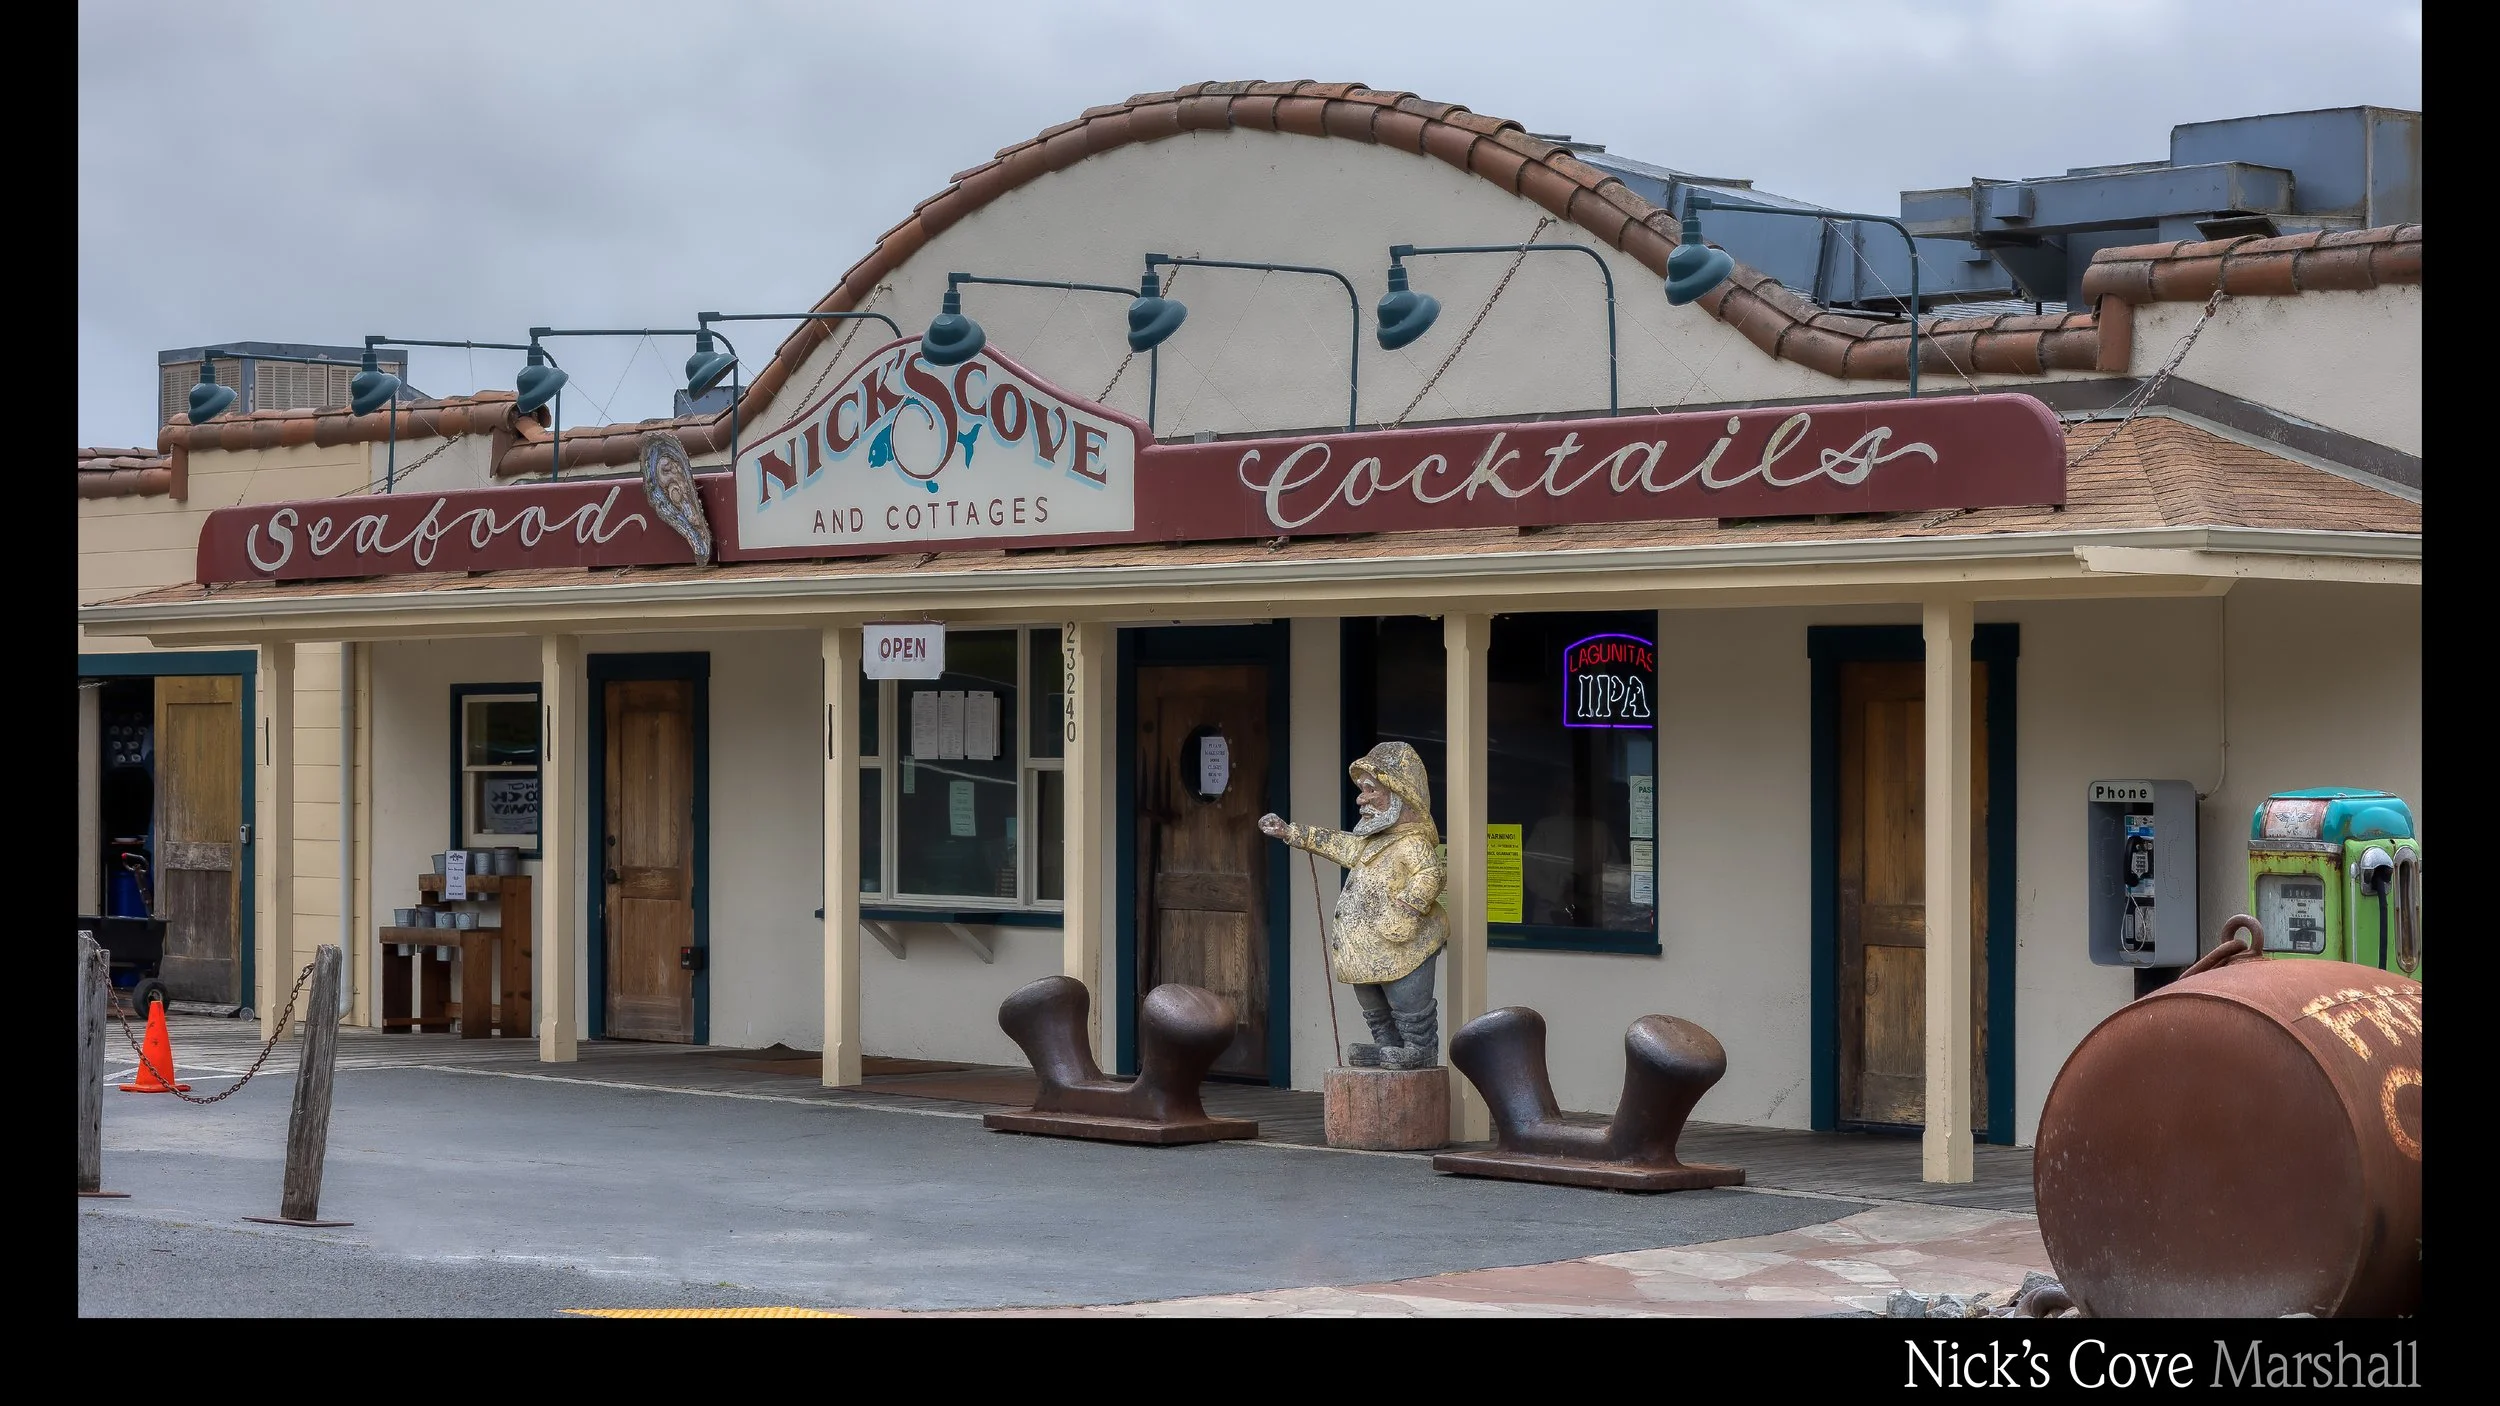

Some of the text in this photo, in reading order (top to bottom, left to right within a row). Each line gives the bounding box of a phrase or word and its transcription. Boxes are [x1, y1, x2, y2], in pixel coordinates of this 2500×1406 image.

[954, 362, 1108, 485] COVE
[1239, 412, 1938, 530] Cocktails
[247, 485, 647, 572] Seafood
[813, 496, 1048, 534] AND COTTAGES
[880, 637, 926, 660] OPEN
[1065, 621, 1076, 743] 23240
[1577, 674, 1650, 717] IPA
[2096, 786, 2148, 799] Phone
